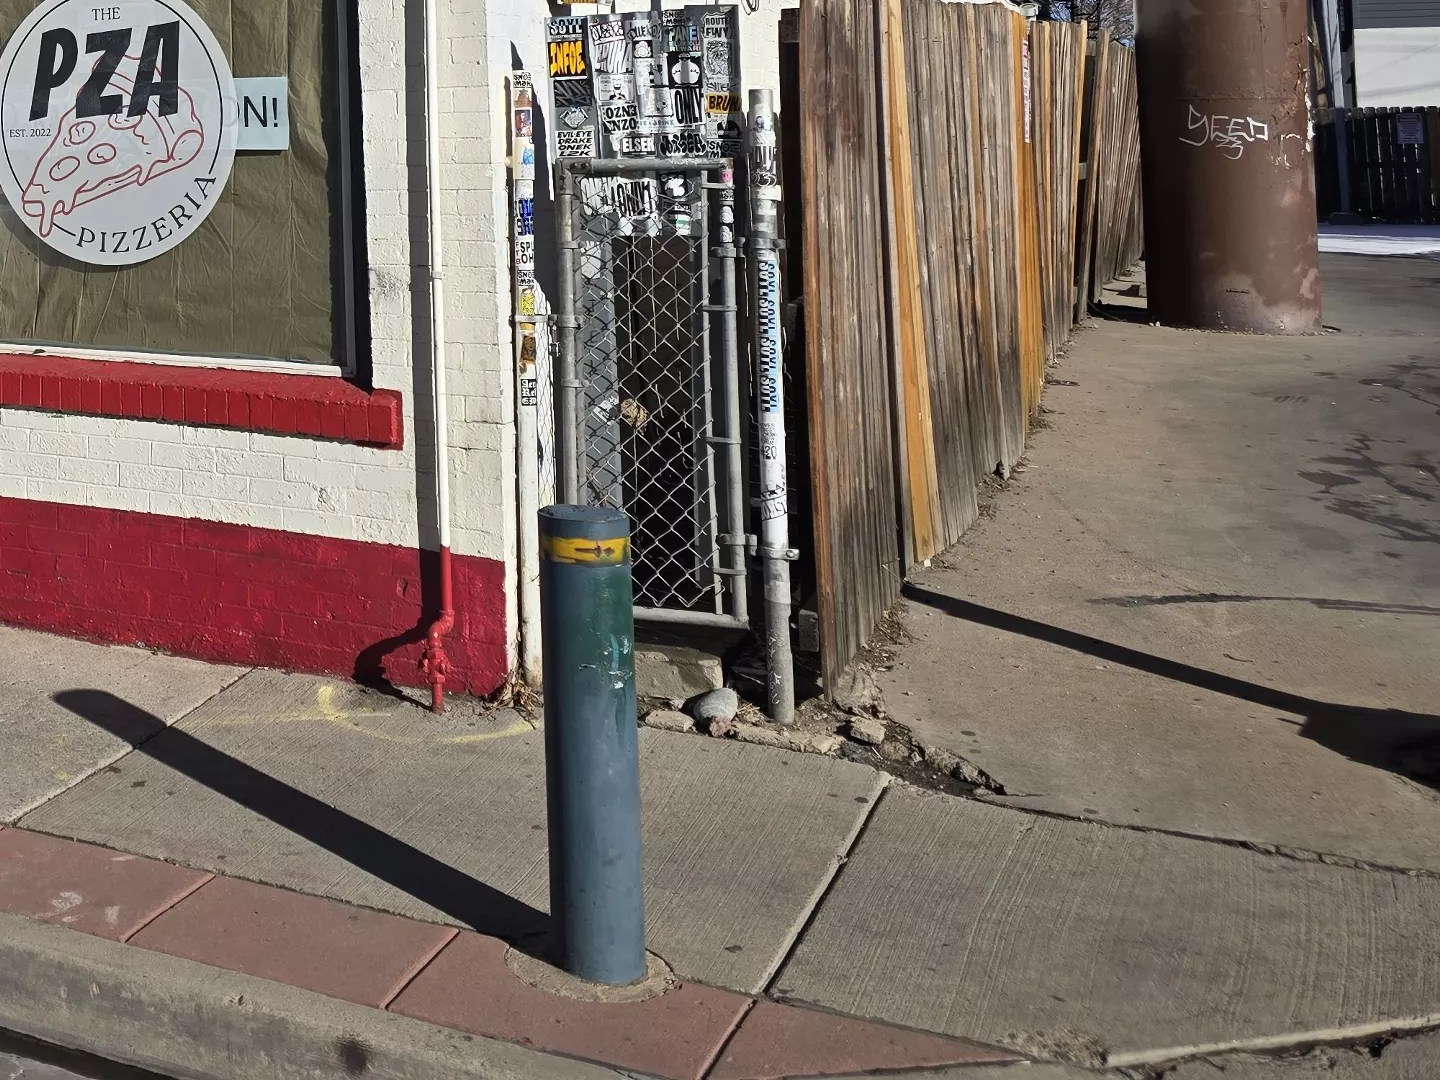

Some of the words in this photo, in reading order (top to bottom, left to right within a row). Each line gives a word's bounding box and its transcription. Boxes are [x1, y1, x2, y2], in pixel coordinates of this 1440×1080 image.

[92, 7, 120, 20] THE
[29, 19, 180, 121] PZA
[10, 129, 28, 137] EST.
[30, 128, 52, 137] 2022
[76, 174, 216, 253] PIZZERIA
